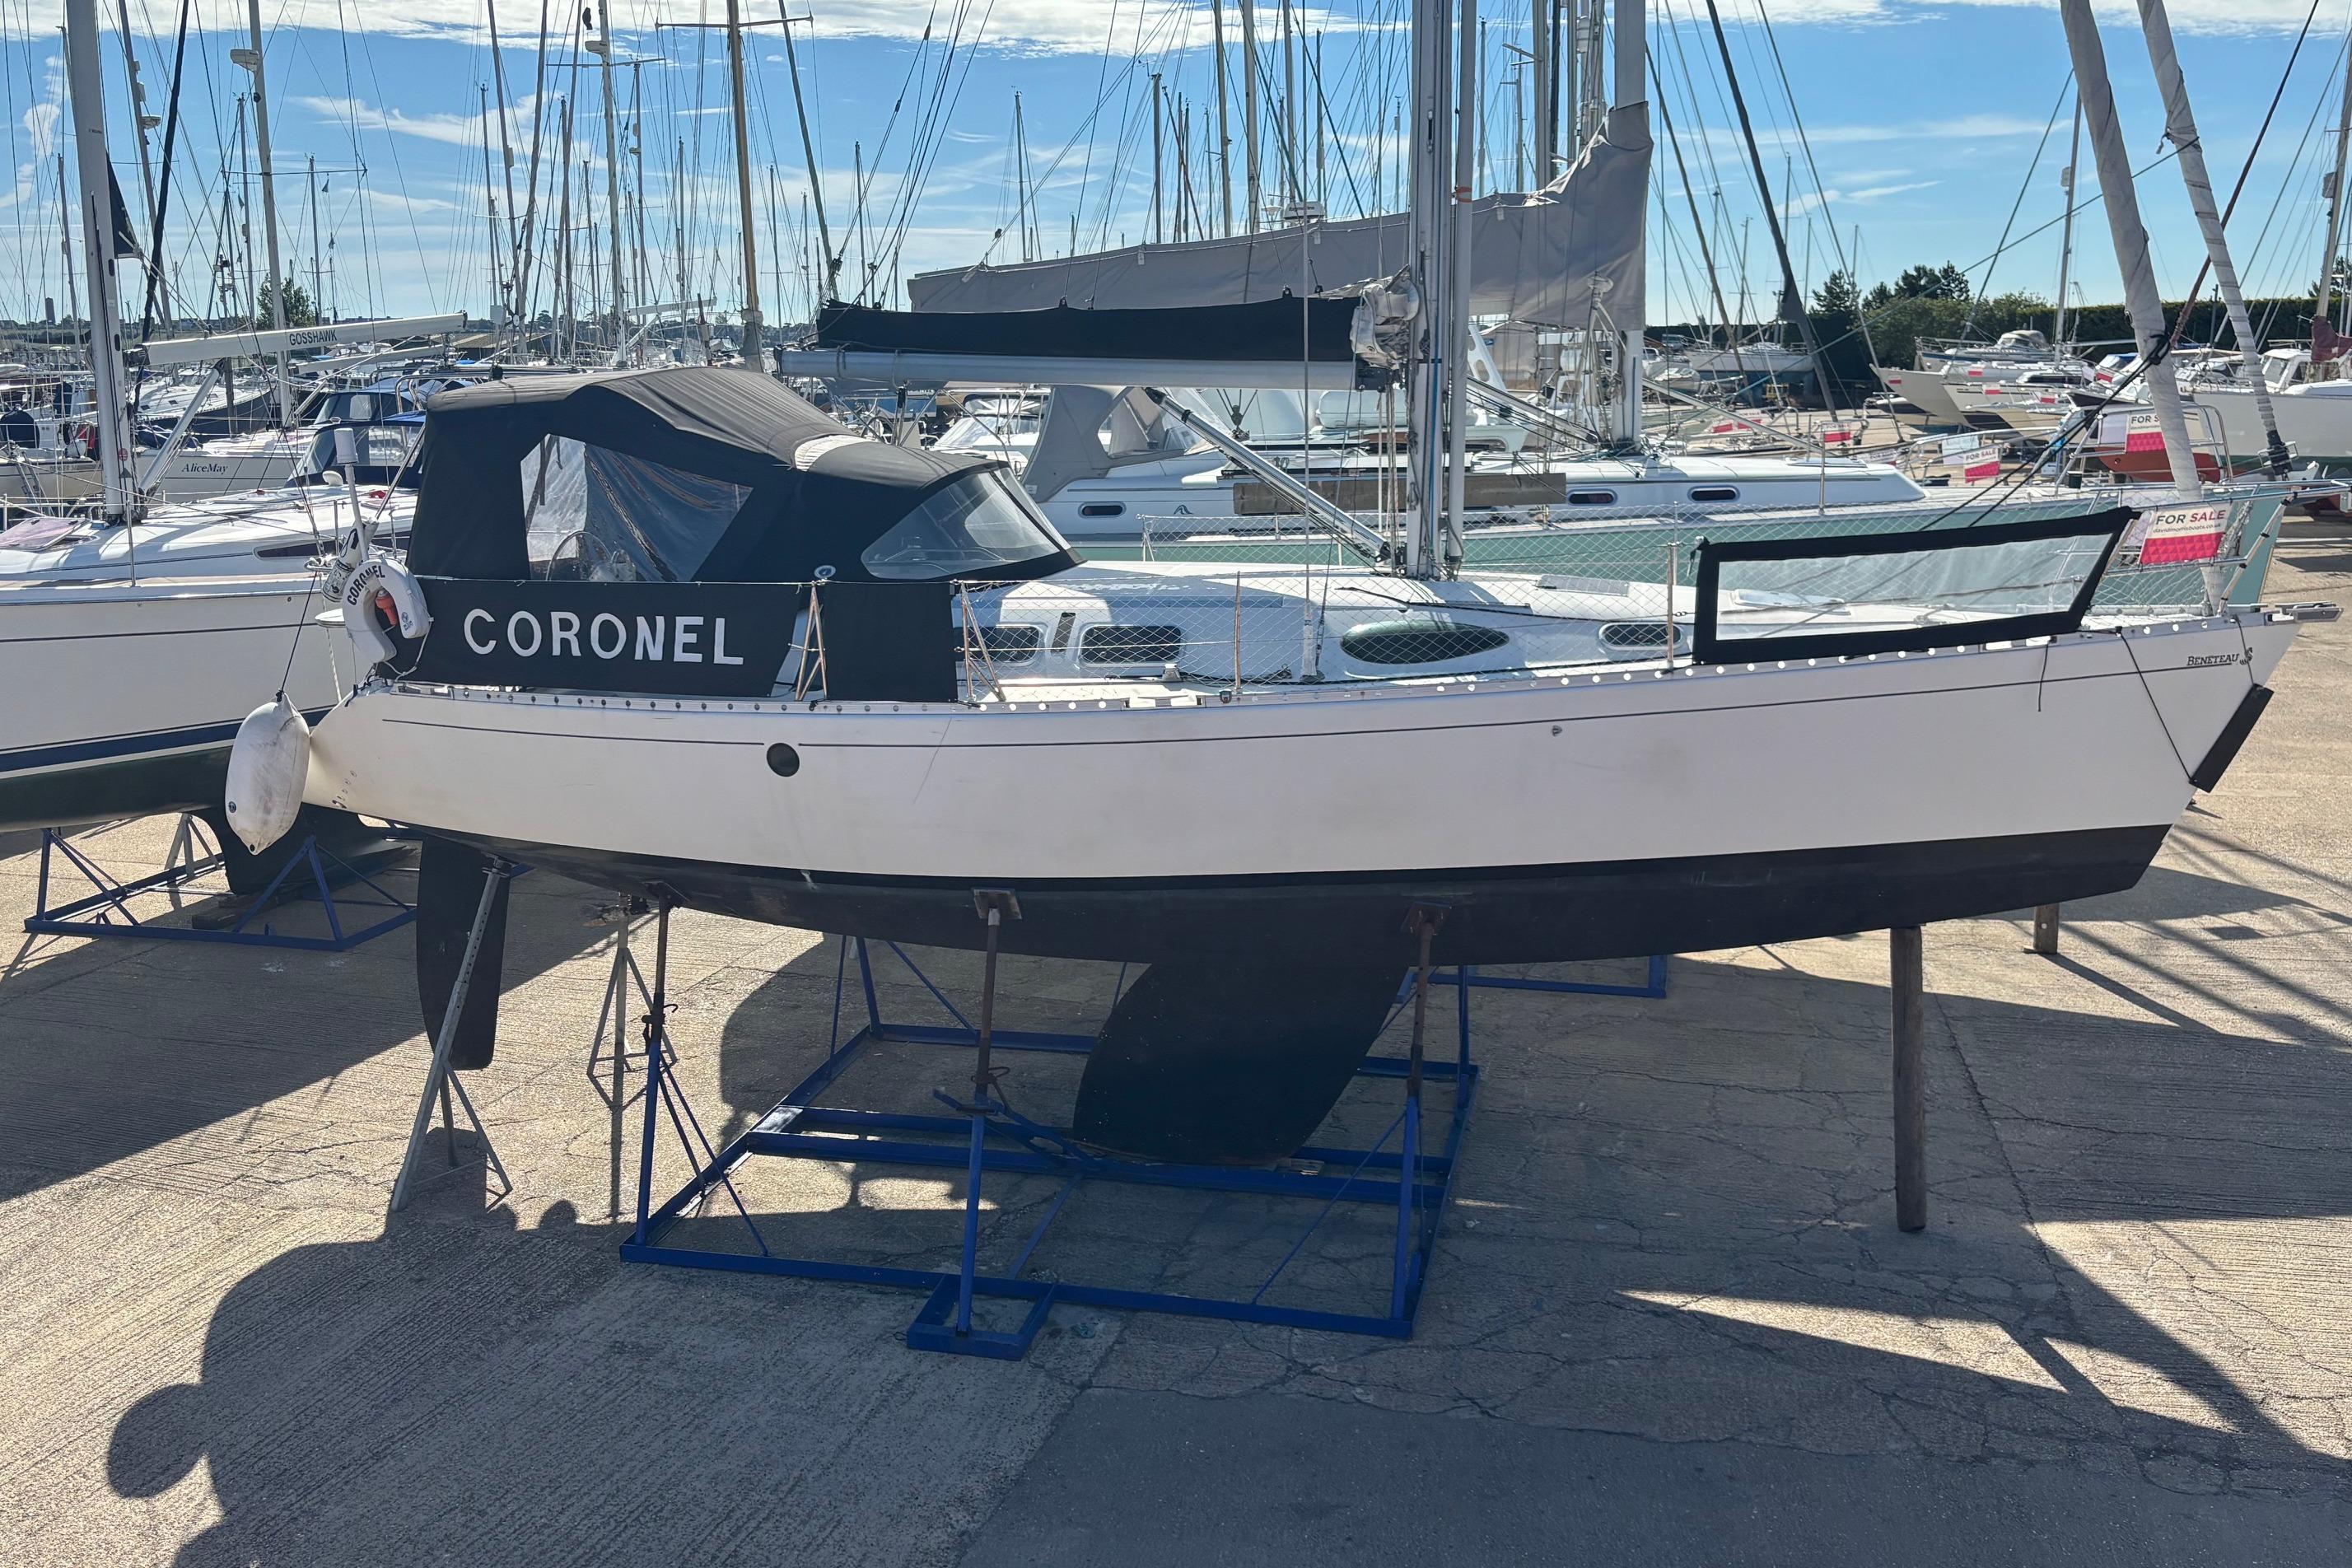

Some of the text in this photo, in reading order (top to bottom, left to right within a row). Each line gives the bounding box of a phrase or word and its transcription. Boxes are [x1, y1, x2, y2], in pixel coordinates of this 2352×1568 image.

[289, 329, 338, 346] GOSSHAWK
[2131, 414, 2152, 424] FOR
[1966, 452, 1980, 461] FOR
[1981, 447, 1996, 457] SALE
[181, 463, 229, 475] AliceMay
[2156, 510, 2227, 525] FOR SALE
[347, 565, 385, 605] CORONEL
[464, 608, 744, 665] CORONEL
